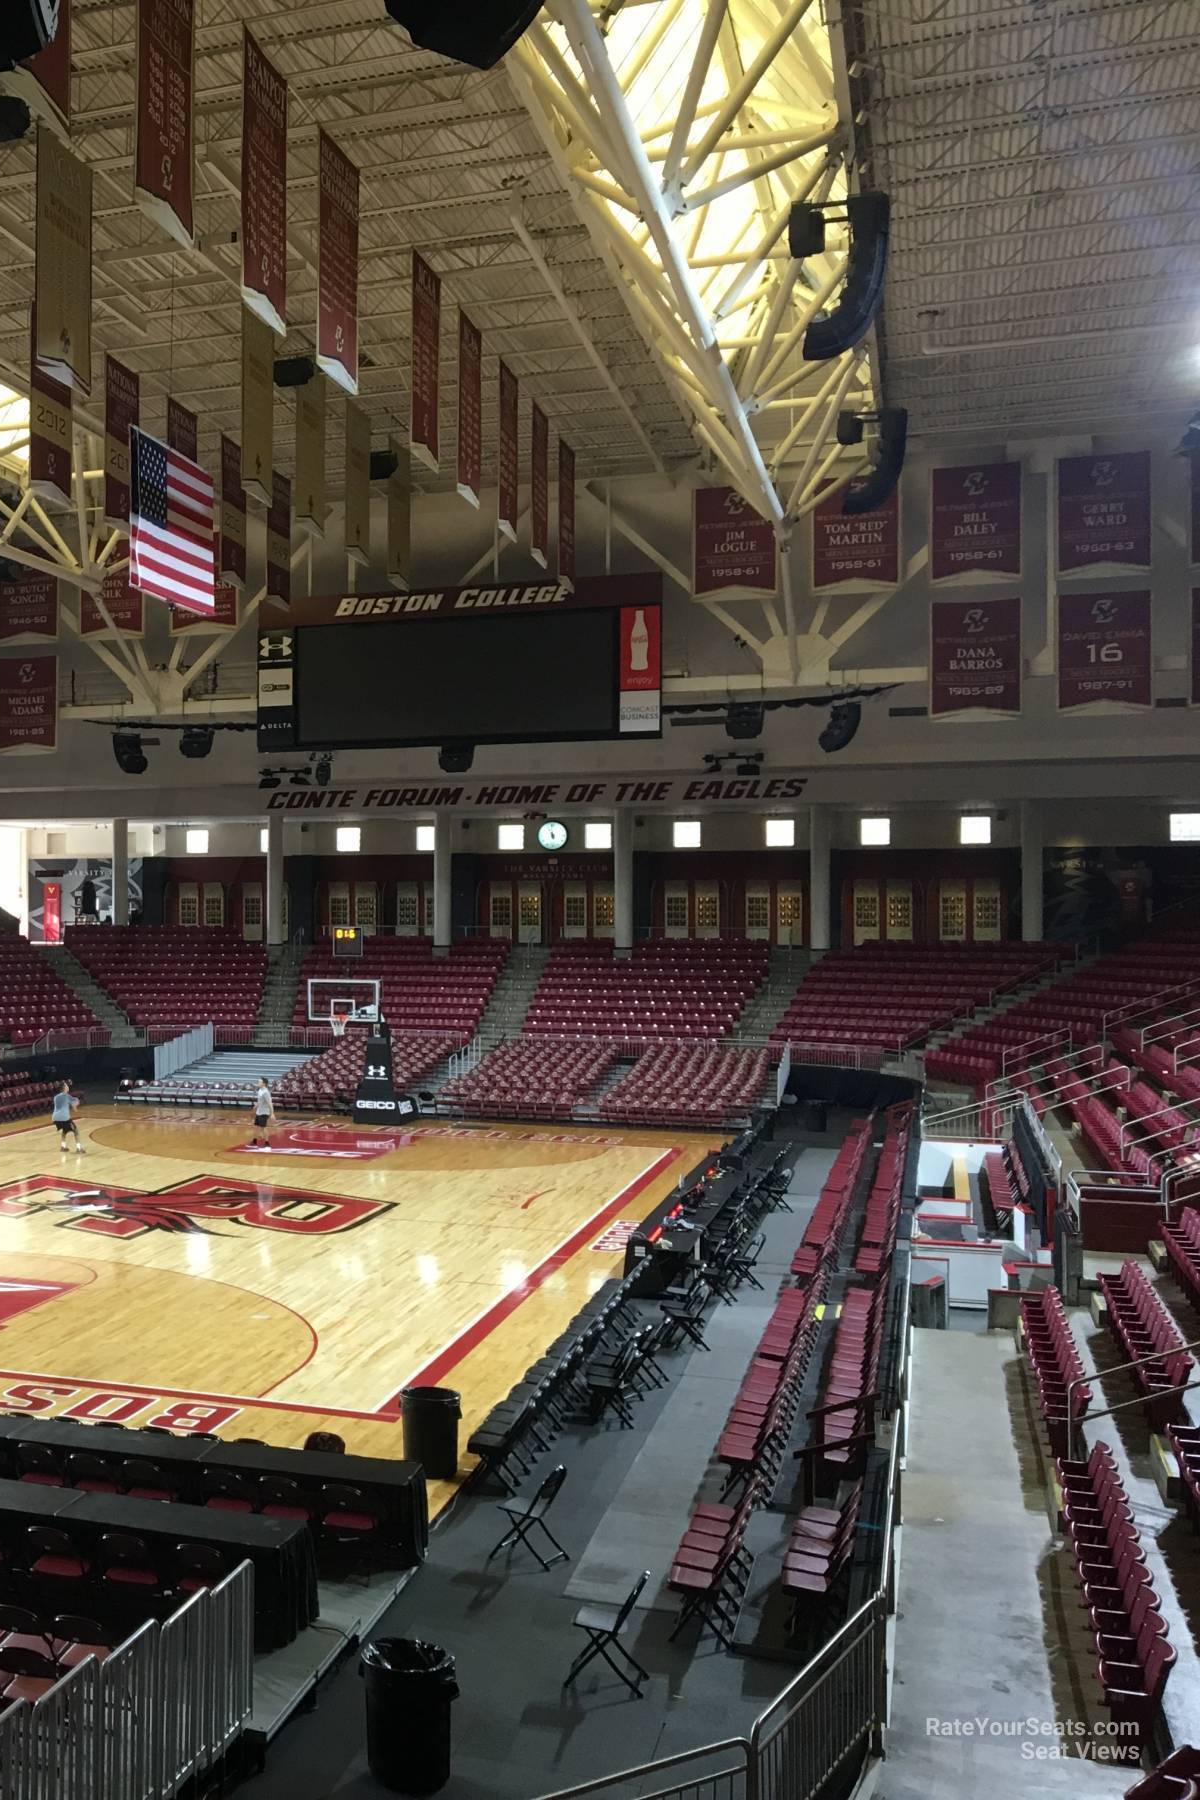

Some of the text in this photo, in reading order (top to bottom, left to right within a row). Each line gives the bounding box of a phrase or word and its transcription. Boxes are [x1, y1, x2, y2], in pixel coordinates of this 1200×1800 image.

[247, 42, 286, 111] BEANPOT
[108, 364, 137, 396] NATIONAL
[37, 404, 66, 436] 2012
[963, 512, 989, 523] BILL
[1082, 514, 1127, 526] WARD
[824, 524, 851, 534] TOM
[953, 523, 998, 536] DALEY
[726, 531, 745, 541] JIM
[829, 532, 882, 546] MARTIN
[714, 541, 757, 553] LOGUE
[1075, 541, 1135, 553] 1960-63
[950, 550, 1003, 561] 1958-61
[832, 559, 881, 569] 1958-61
[712, 567, 760, 577] 1958-61
[103, 580, 123, 588] OHN
[4, 585, 15, 595] ED
[101, 589, 122, 598] SILK
[10, 593, 45, 605] SONGIN
[335, 585, 569, 616] BOSTON COLLEGE
[957, 647, 995, 658] DANA
[1086, 642, 1123, 664] 16
[949, 658, 1003, 670] BARROS
[627, 676, 653, 686] enjoy
[1077, 680, 1134, 691] 1987-91
[948, 685, 1004, 696] 1985-89
[8, 696, 46, 705] MICHAEL
[11, 705, 44, 715] ADAMS
[621, 704, 659, 714] COMCAST
[621, 712, 658, 721] BUSINESS
[267, 721, 292, 730] DELTA
[267, 778, 807, 809] CONTE FORUM HOME OF THE EAGLES
[356, 1100, 396, 1110] GEICO
